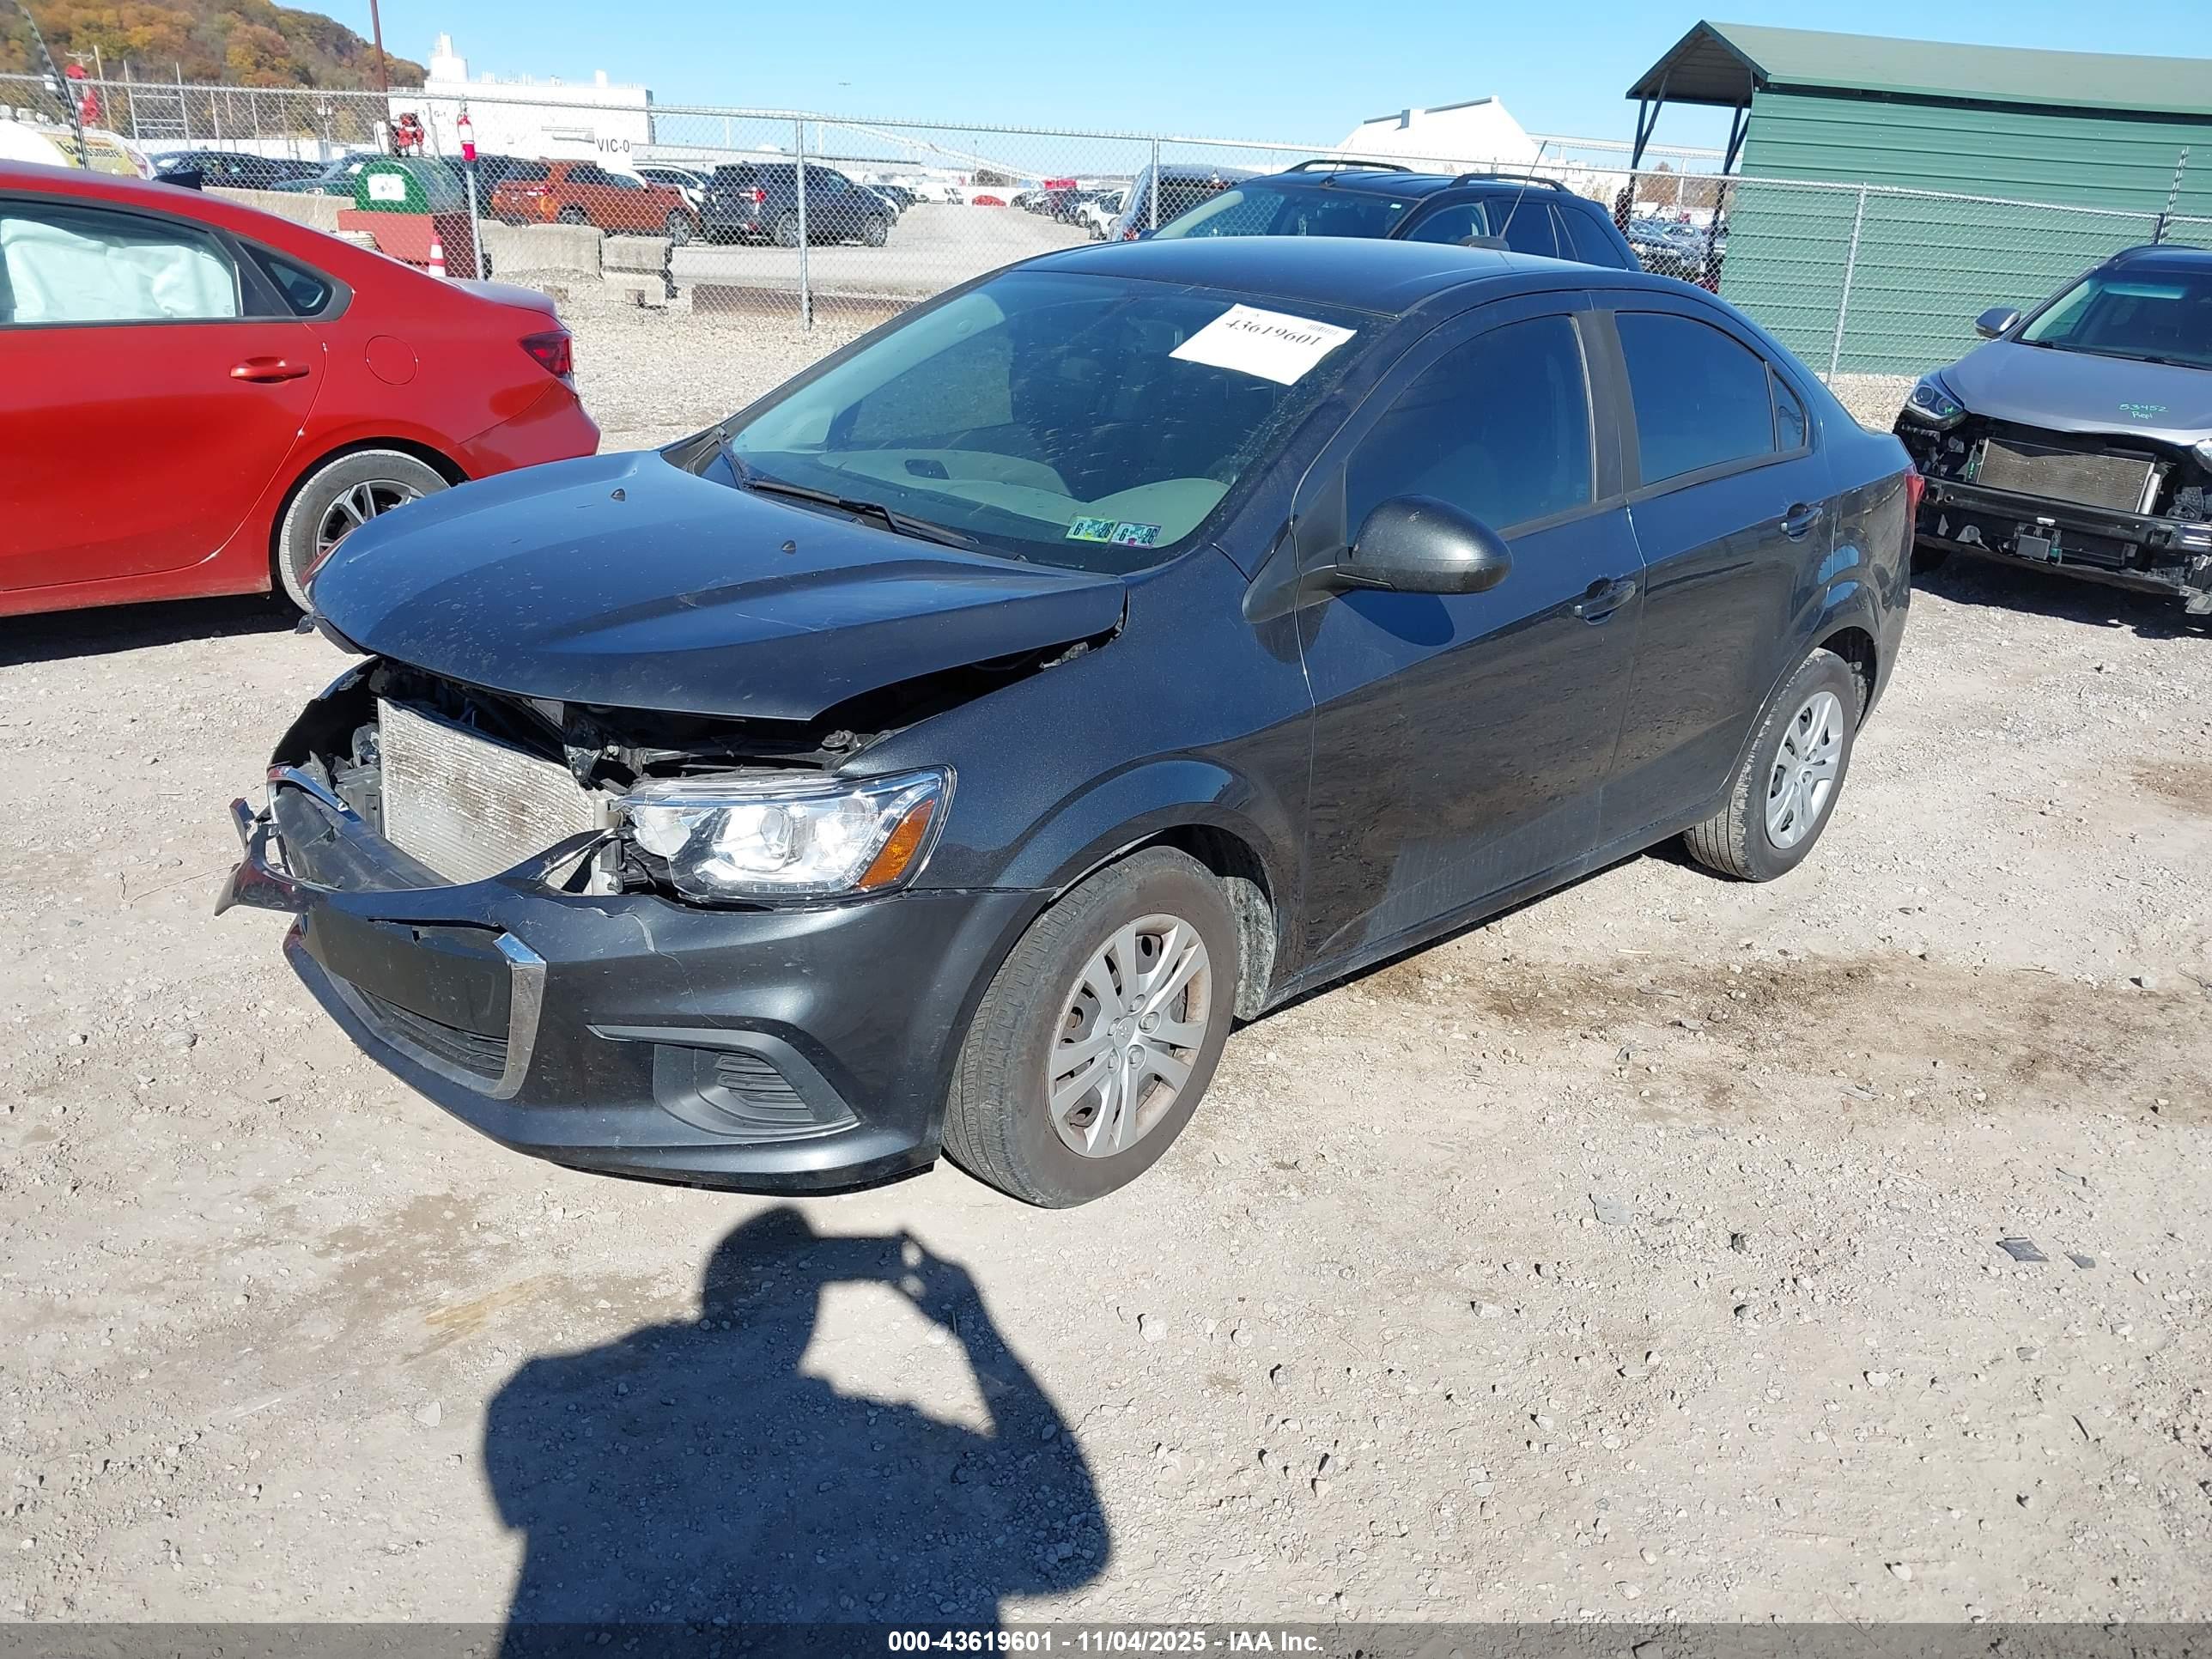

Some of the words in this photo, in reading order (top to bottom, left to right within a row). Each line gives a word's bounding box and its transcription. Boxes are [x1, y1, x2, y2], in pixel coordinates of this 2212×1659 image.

[1225, 319, 1322, 346] 43619601
[1073, 522, 1084, 536] 6
[1099, 522, 1115, 538] 26
[1118, 527, 1129, 542] 6
[1142, 527, 1158, 544] 26
